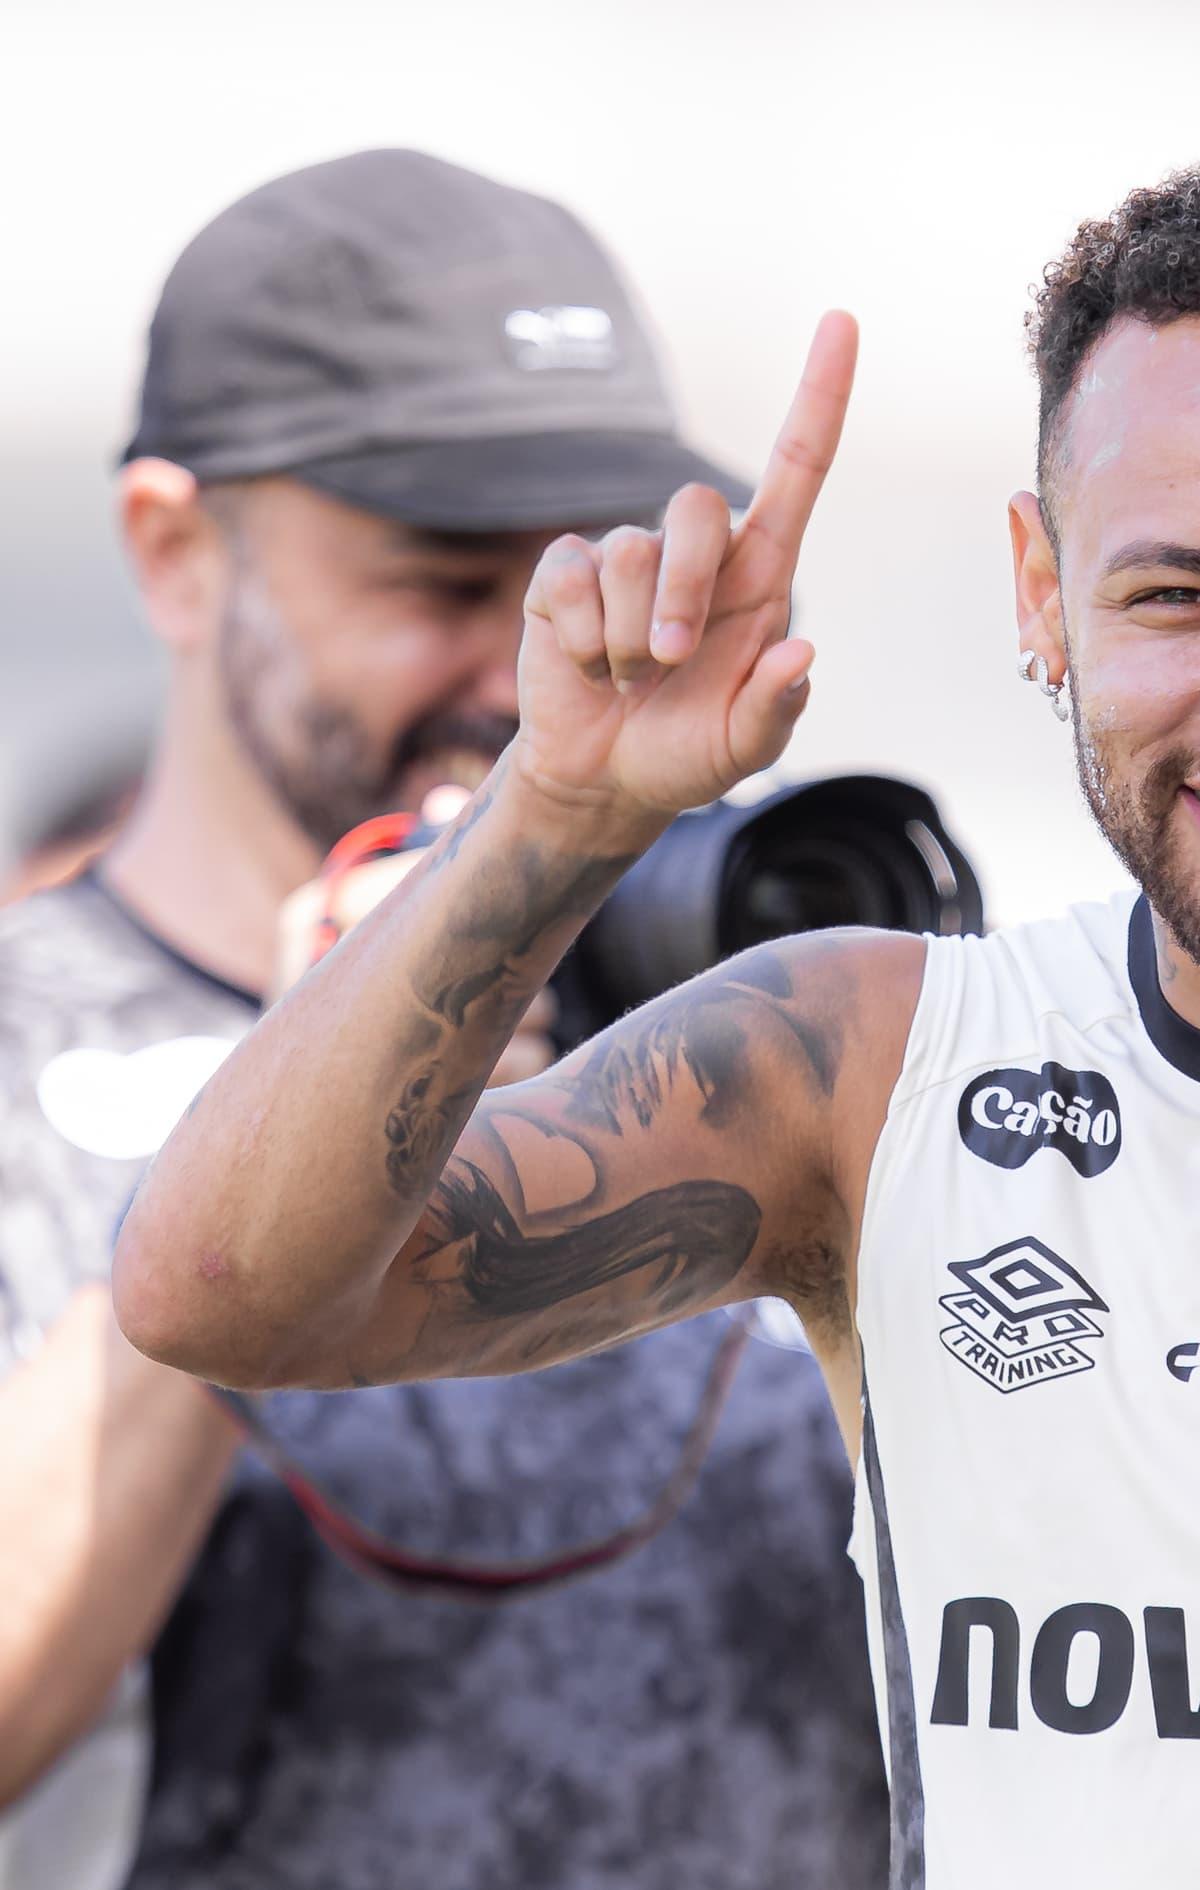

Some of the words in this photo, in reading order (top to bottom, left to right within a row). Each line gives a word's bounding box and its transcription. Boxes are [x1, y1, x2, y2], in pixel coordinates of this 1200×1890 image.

[971, 1086, 1117, 1146] Cação
[953, 1298, 1090, 1346] PRO
[952, 1330, 1079, 1384] TRAINING
